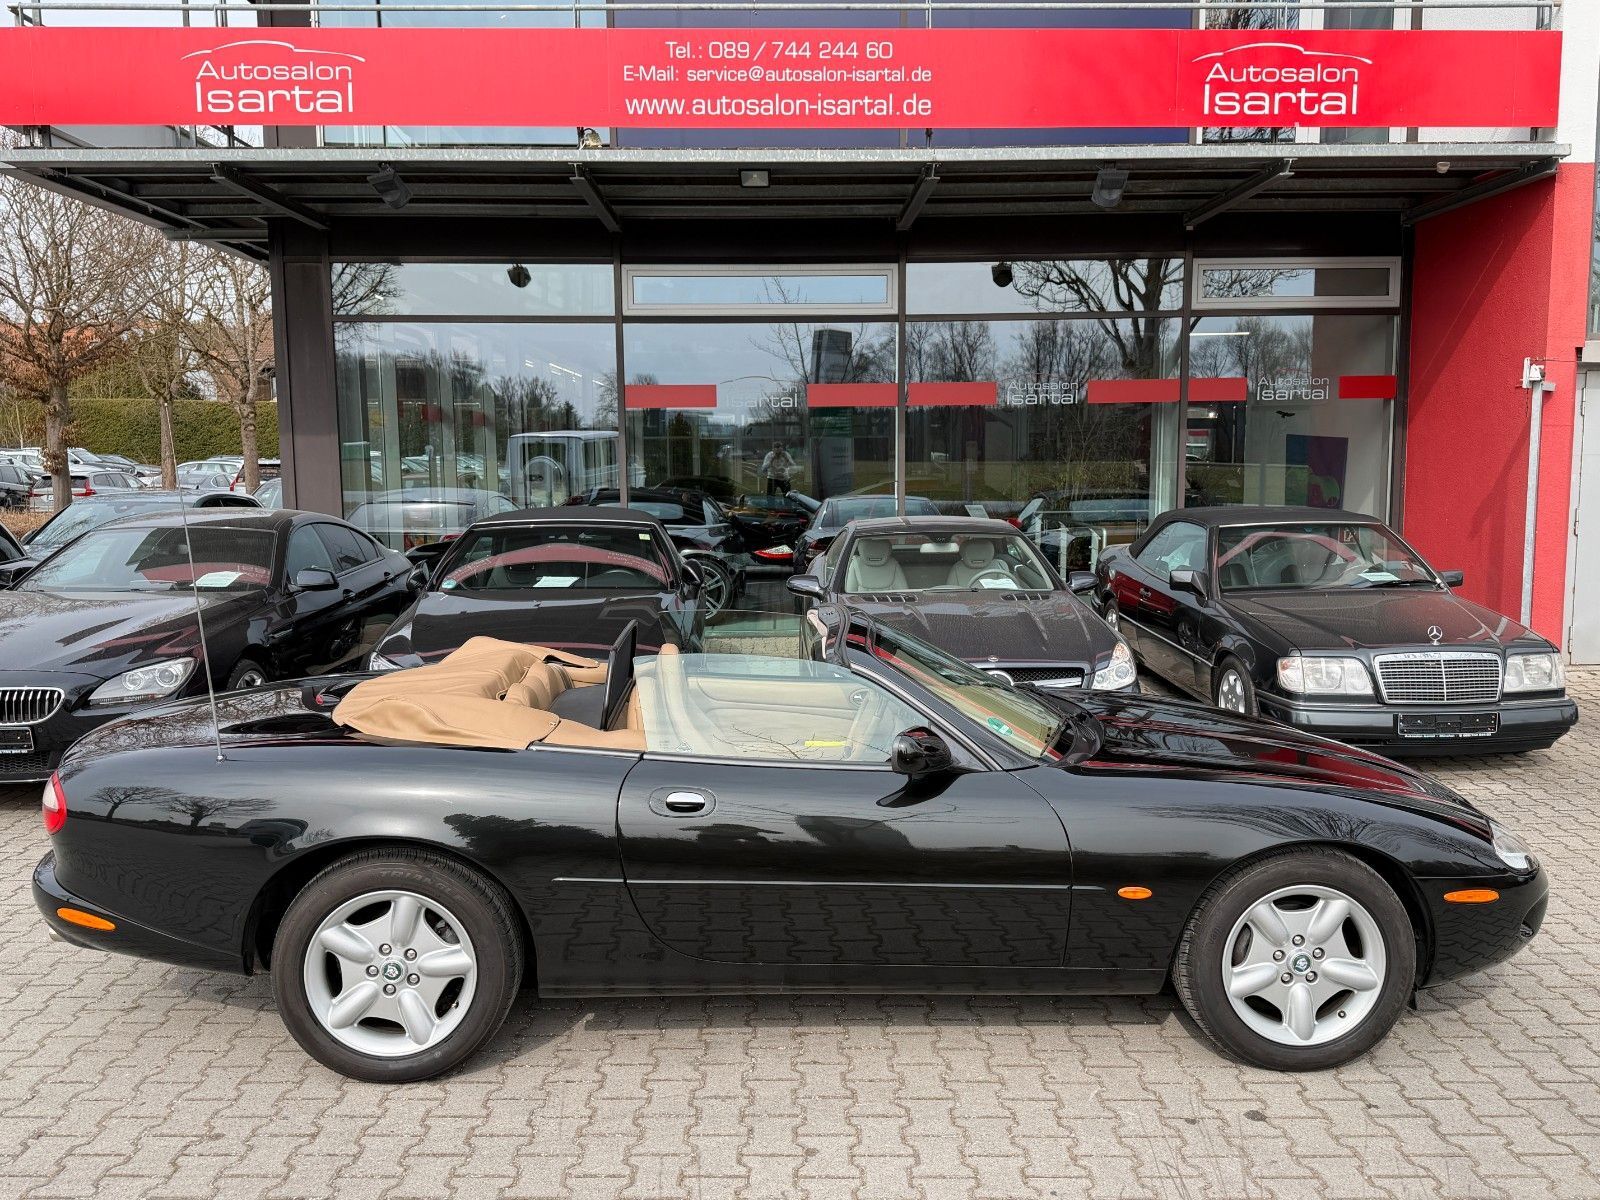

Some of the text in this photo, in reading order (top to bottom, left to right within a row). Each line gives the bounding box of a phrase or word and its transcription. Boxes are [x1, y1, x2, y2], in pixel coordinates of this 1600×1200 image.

[664, 41, 703, 59] Tel.:
[708, 41, 750, 59] 089
[771, 41, 812, 59] 744
[819, 41, 859, 59] 244
[866, 41, 894, 59] 60
[195, 60, 353, 81] Autosalon
[623, 66, 932, 83] E-Mail: service@autosalon-isartal.de
[1205, 62, 1359, 83] Autosalon
[195, 81, 354, 113] Isartal
[625, 93, 932, 116] www.autosalon-isartal.de
[1203, 83, 1358, 115] Isartal
[1007, 380, 1079, 390] Autosalon
[1257, 376, 1330, 386] Autosalon
[1007, 389, 1078, 405] Isartal
[1256, 385, 1329, 401] Isartal
